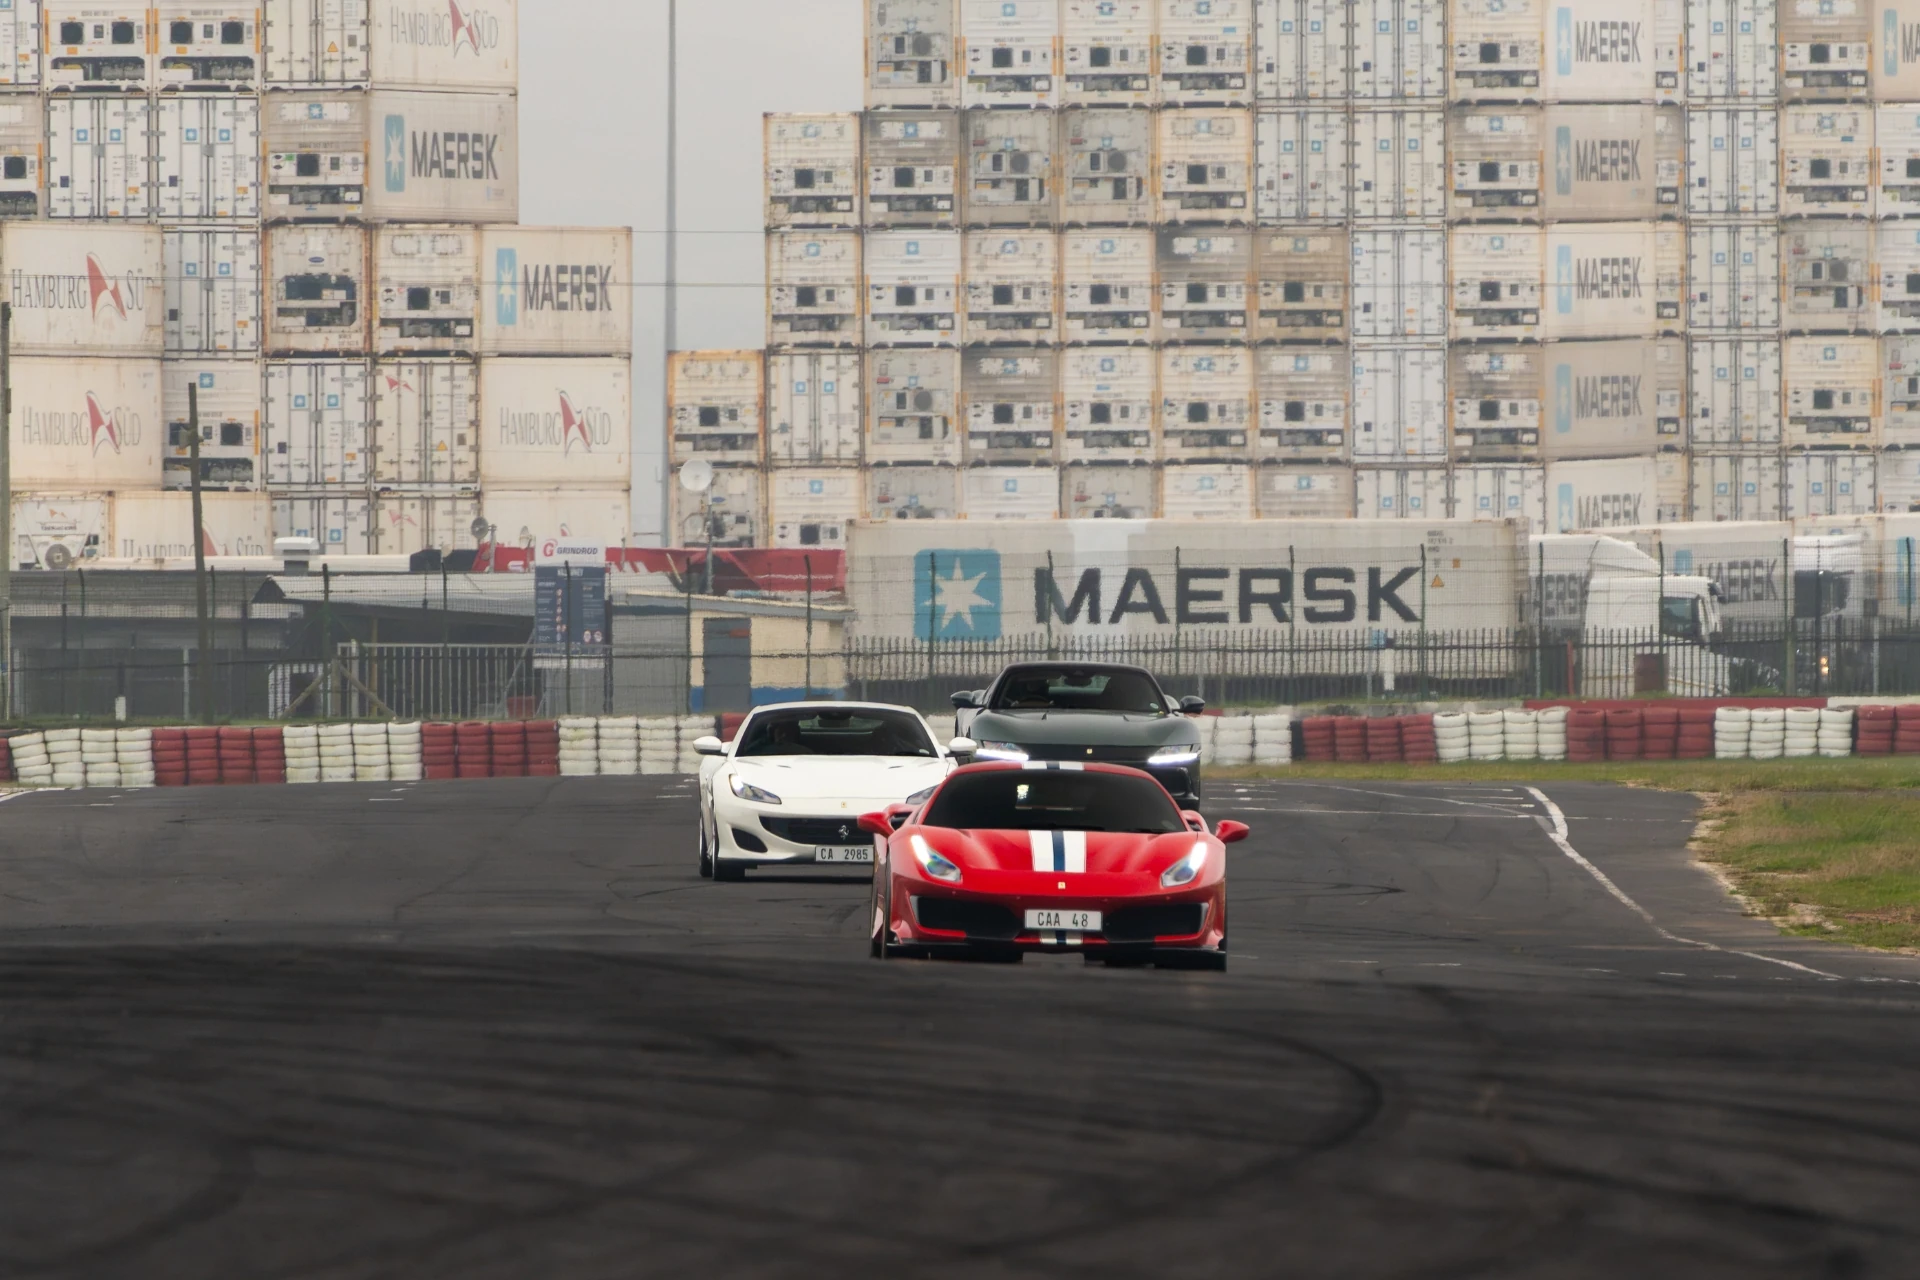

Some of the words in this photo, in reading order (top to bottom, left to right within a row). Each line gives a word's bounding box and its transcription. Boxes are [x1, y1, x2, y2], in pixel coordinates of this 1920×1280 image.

[390, 6, 451, 47] HAMBURG
[473, 9, 499, 49] SÜD
[1576, 20, 1641, 62] MAERSK
[411, 130, 498, 180] MAERSK
[1575, 139, 1641, 182] MAERSK
[11, 269, 87, 309] HAMBURG
[126, 268, 155, 311] SÜ
[523, 263, 612, 312] MAERSK
[1576, 257, 1642, 299] MAERSK
[1575, 374, 1642, 419] MAERSK
[22, 406, 89, 446] HAMBURG
[114, 406, 141, 446] SÜD
[500, 407, 562, 446] HAMBURG
[586, 406, 612, 446] SÜD
[557, 547, 598, 555] GRINDROD
[1033, 566, 1423, 624] MAERSK
[820, 849, 834, 860] CA
[844, 848, 869, 860] 2985
[1037, 912, 1061, 927] CAA
[1072, 912, 1089, 928] 48
